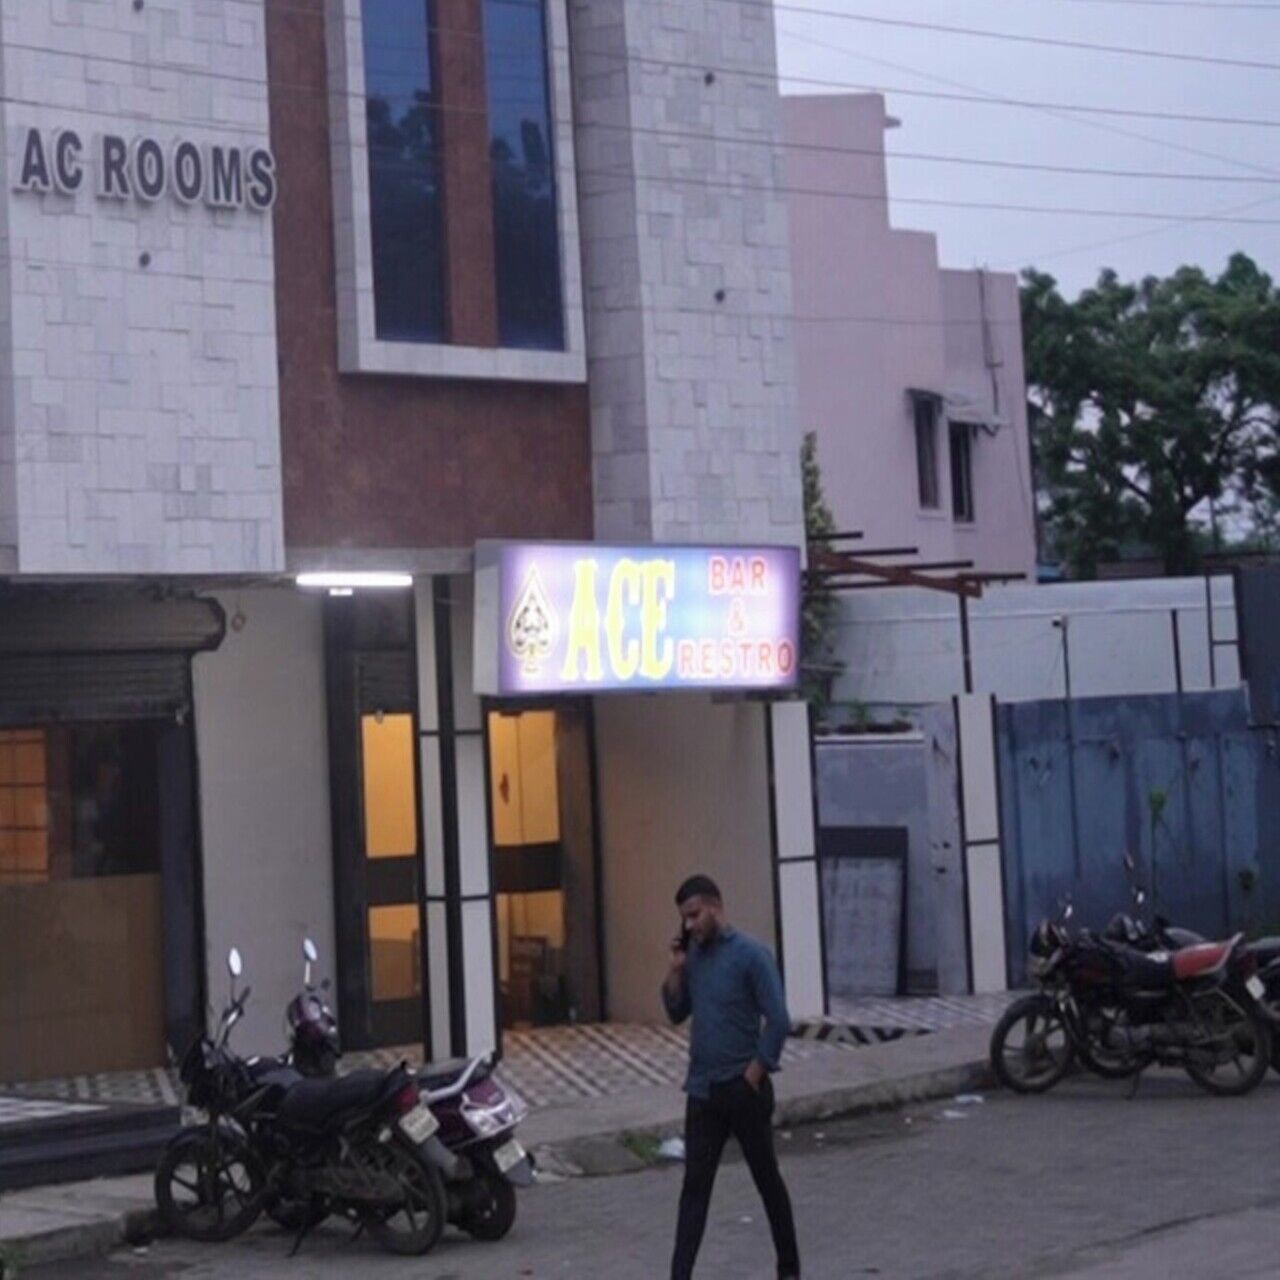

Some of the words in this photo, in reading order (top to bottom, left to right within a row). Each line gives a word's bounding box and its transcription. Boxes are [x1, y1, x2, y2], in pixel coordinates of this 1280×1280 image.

[17, 127, 83, 192] AC
[100, 134, 276, 209] ROOMS
[710, 558, 766, 592] BAR
[560, 557, 676, 681] ACE
[730, 600, 744, 633] &
[679, 640, 794, 676] RESTRO
